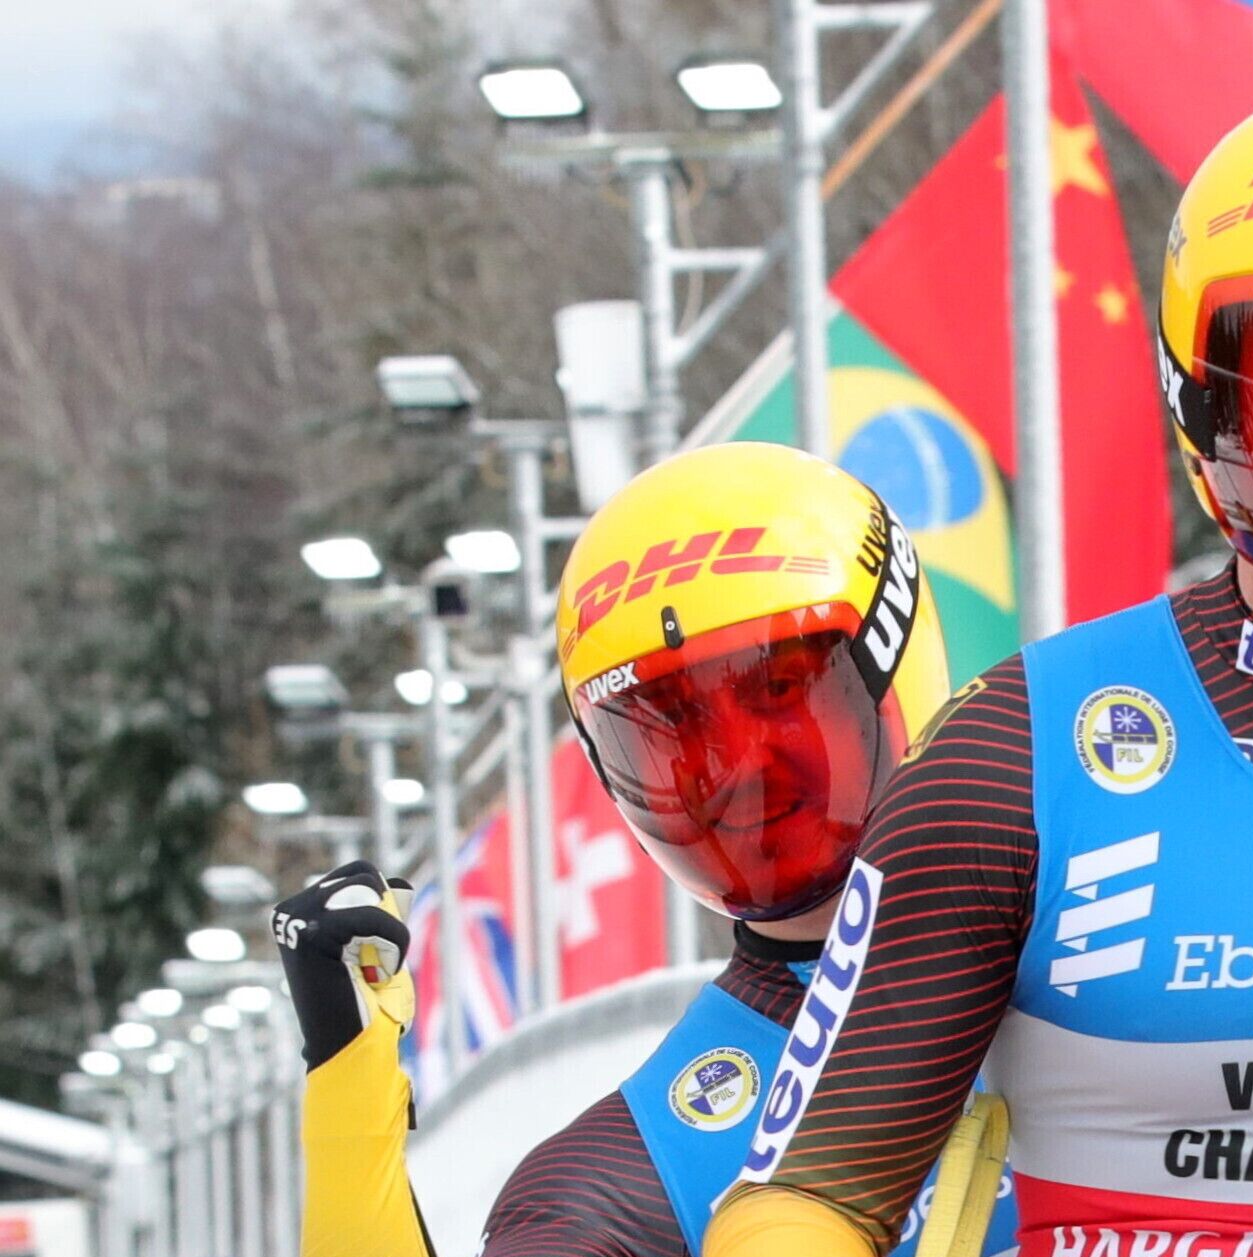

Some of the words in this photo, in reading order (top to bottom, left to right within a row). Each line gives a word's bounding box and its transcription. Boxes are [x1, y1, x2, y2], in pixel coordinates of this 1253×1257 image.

[574, 527, 785, 640] DHL
[585, 661, 639, 704] uvex
[1116, 748, 1144, 763] FIL
[745, 868, 872, 1173] teuto
[710, 1087, 735, 1106] FIL
